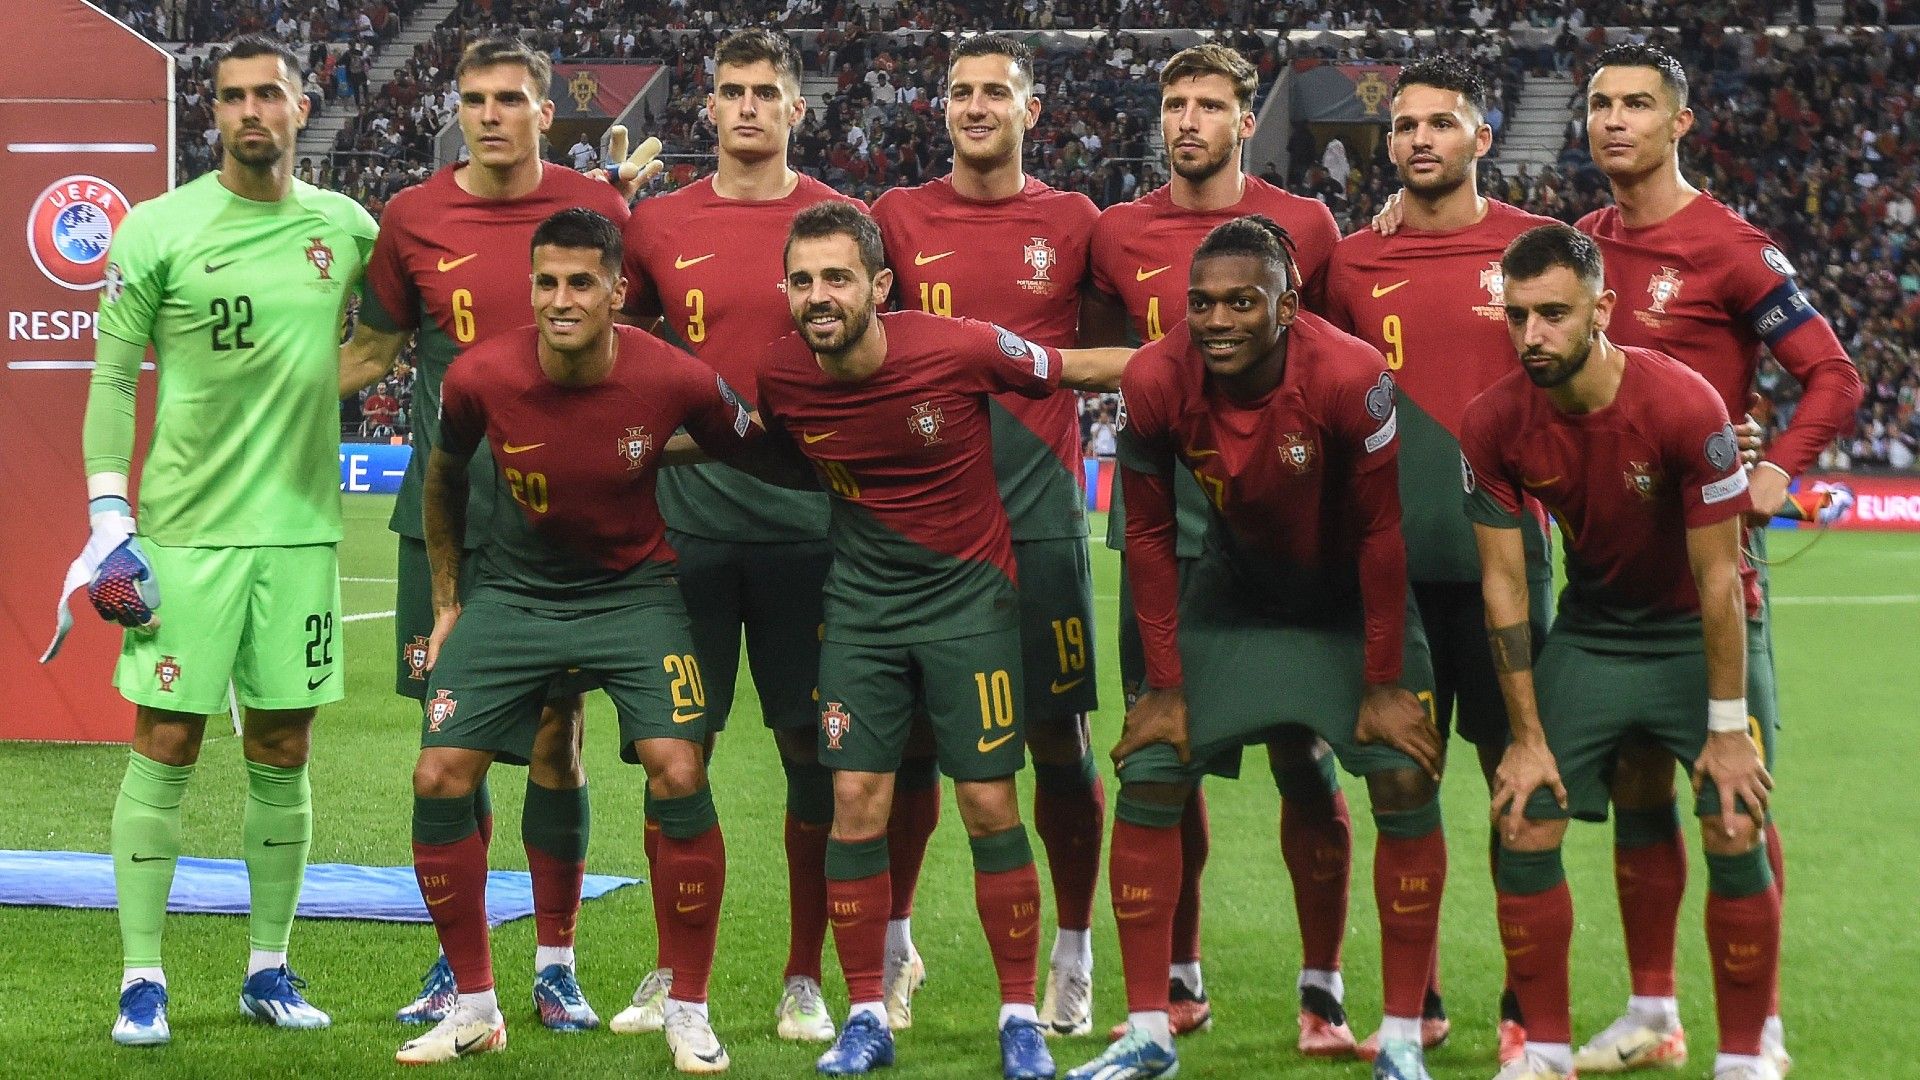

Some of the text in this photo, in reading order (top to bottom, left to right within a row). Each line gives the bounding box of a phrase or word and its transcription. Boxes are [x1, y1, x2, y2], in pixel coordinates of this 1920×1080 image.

[49, 183, 113, 209] UEFA
[8, 310, 99, 341] RESP
[210, 295, 254, 351] 22
[452, 289, 475, 343] 6
[686, 289, 705, 343] 3
[919, 282, 952, 316] 19
[1147, 297, 1164, 341] 4
[1382, 315, 1404, 370] 9
[339, 453, 371, 492] E
[505, 467, 548, 513] 20
[1857, 495, 1920, 520] EURO
[305, 611, 334, 669] 22
[1052, 617, 1085, 674] 19
[663, 654, 705, 707] 20
[974, 669, 1014, 730] 10
